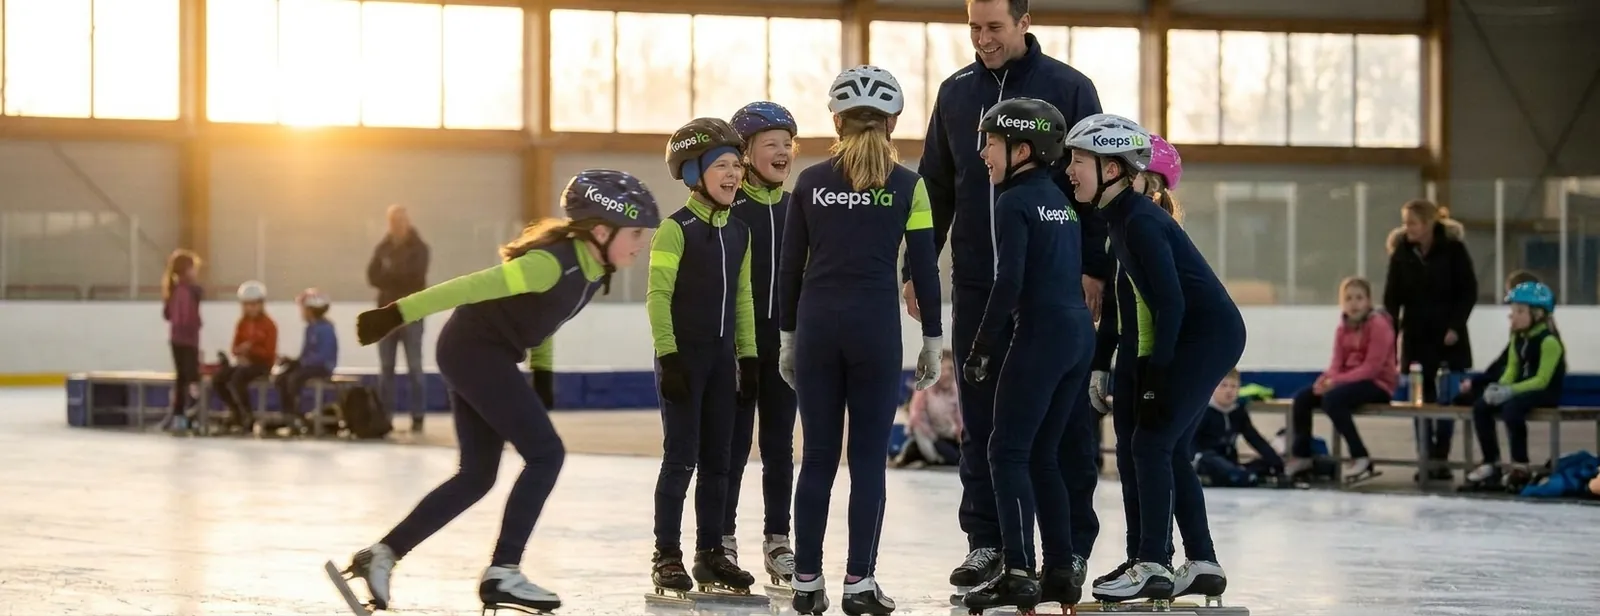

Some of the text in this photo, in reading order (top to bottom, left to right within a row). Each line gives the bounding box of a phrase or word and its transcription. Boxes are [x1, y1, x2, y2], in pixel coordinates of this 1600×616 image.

[996, 114, 1051, 131] KeepsYa
[584, 185, 639, 219] KeepsYa
[812, 187, 894, 209] KeepsYa
